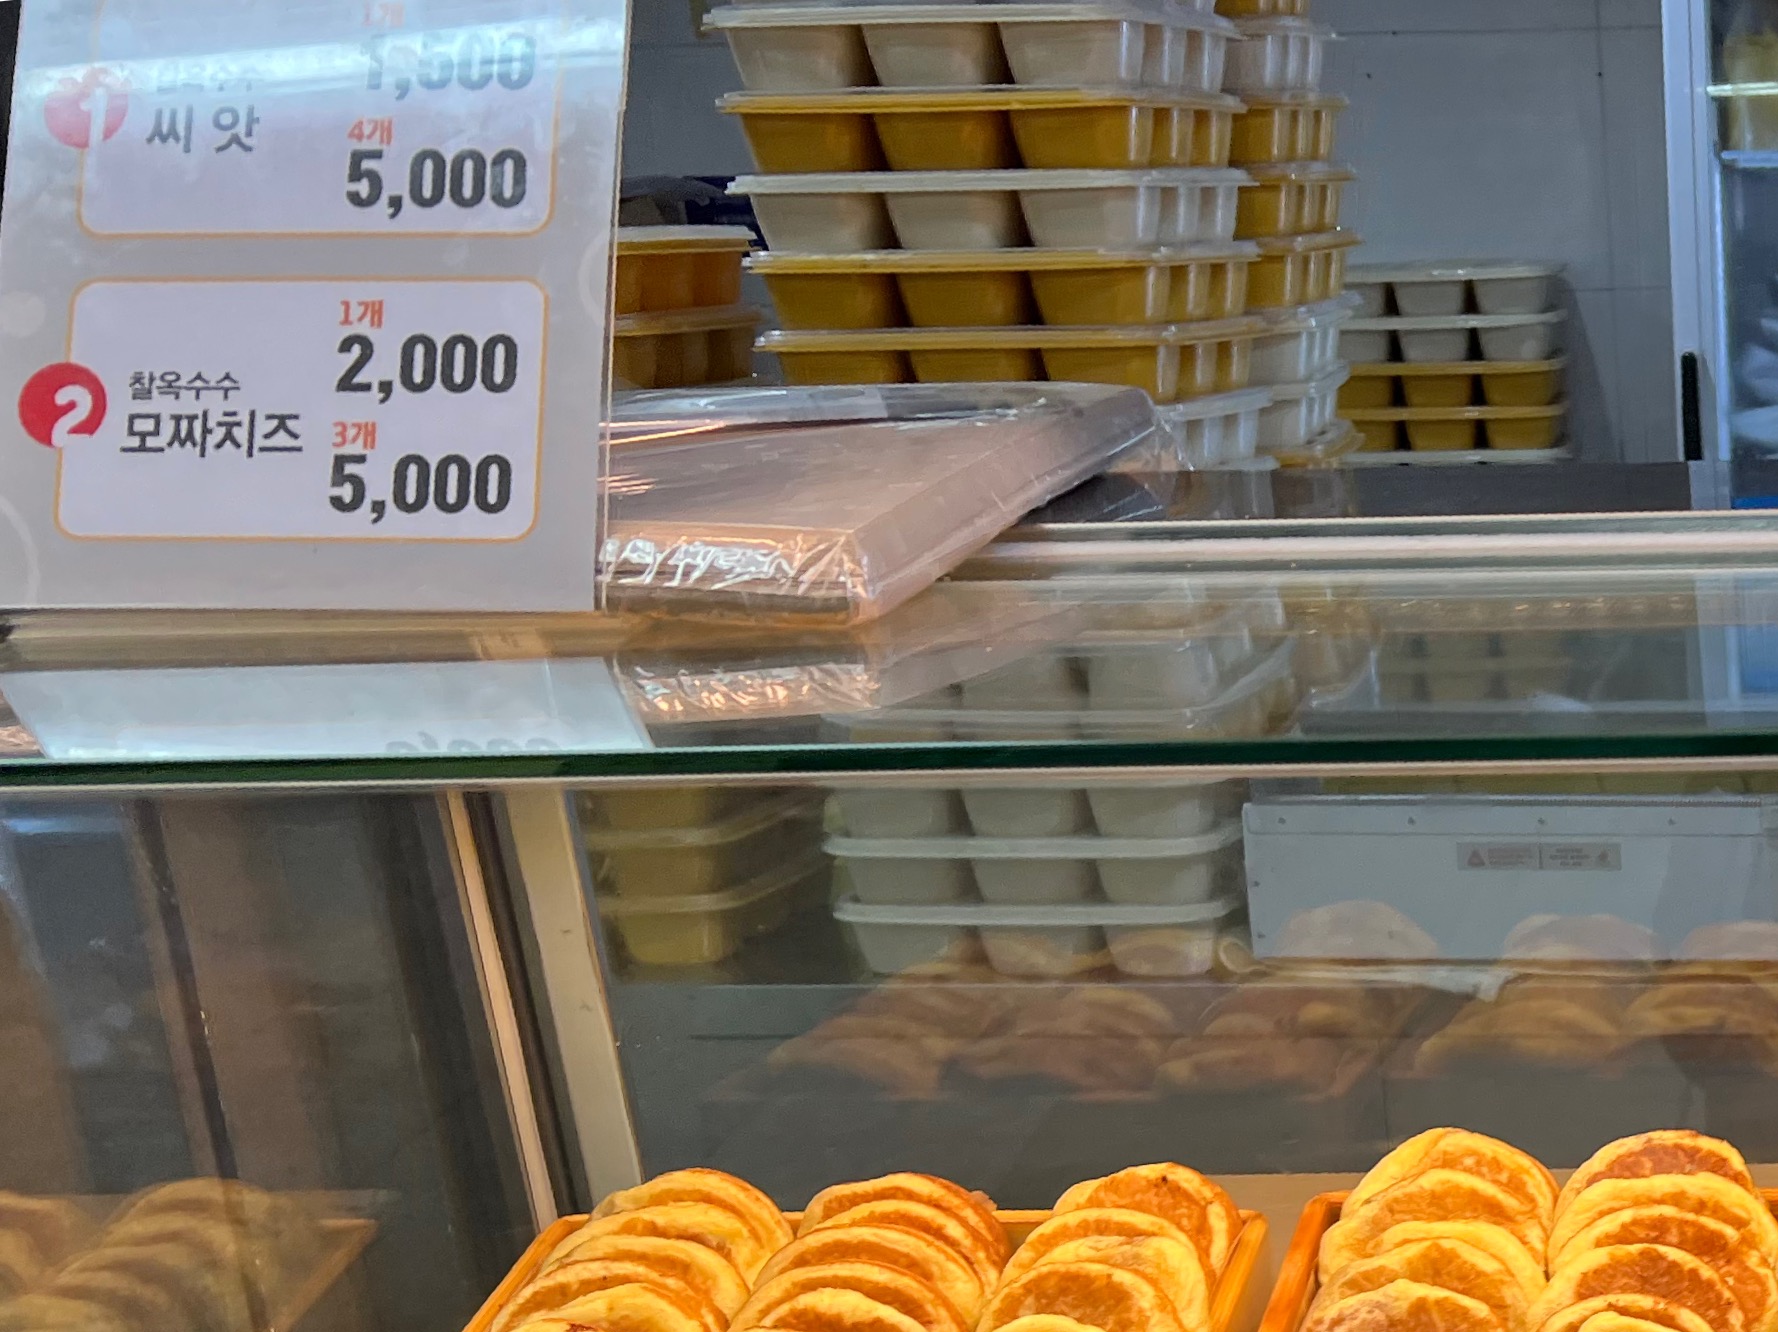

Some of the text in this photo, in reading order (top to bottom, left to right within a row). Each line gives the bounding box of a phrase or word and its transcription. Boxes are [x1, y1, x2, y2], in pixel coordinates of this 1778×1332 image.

[362, 32, 536, 101] 1,500
[347, 118, 393, 145] 4개
[345, 148, 527, 219] 5,000
[339, 300, 384, 328] 1개
[129, 371, 240, 401] 찰옥수수
[335, 333, 518, 404] 2,000
[119, 409, 303, 457] 모짜치즈
[332, 422, 377, 450] 3개
[328, 453, 512, 524] 5,000
